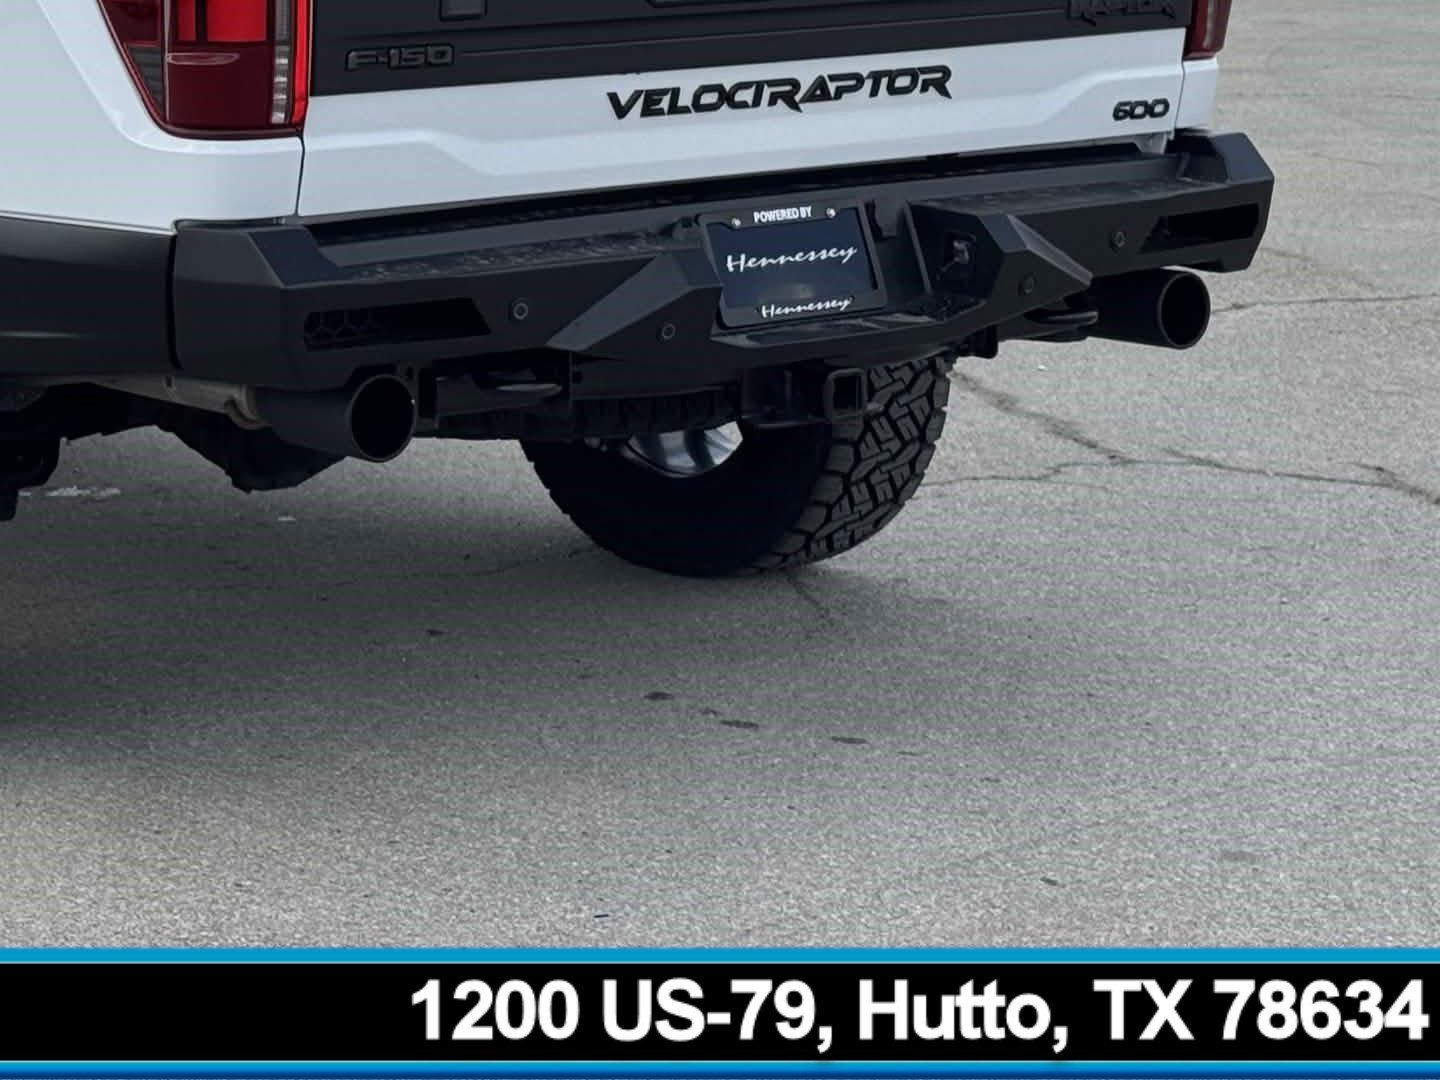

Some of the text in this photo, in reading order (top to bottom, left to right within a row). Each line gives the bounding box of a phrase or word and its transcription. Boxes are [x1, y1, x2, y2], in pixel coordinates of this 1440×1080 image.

[345, 43, 455, 72] F-150
[1112, 97, 1170, 121] 600
[753, 205, 812, 224] POWERED BY
[726, 246, 859, 273] Hennessey
[761, 296, 853, 319] Hennessey
